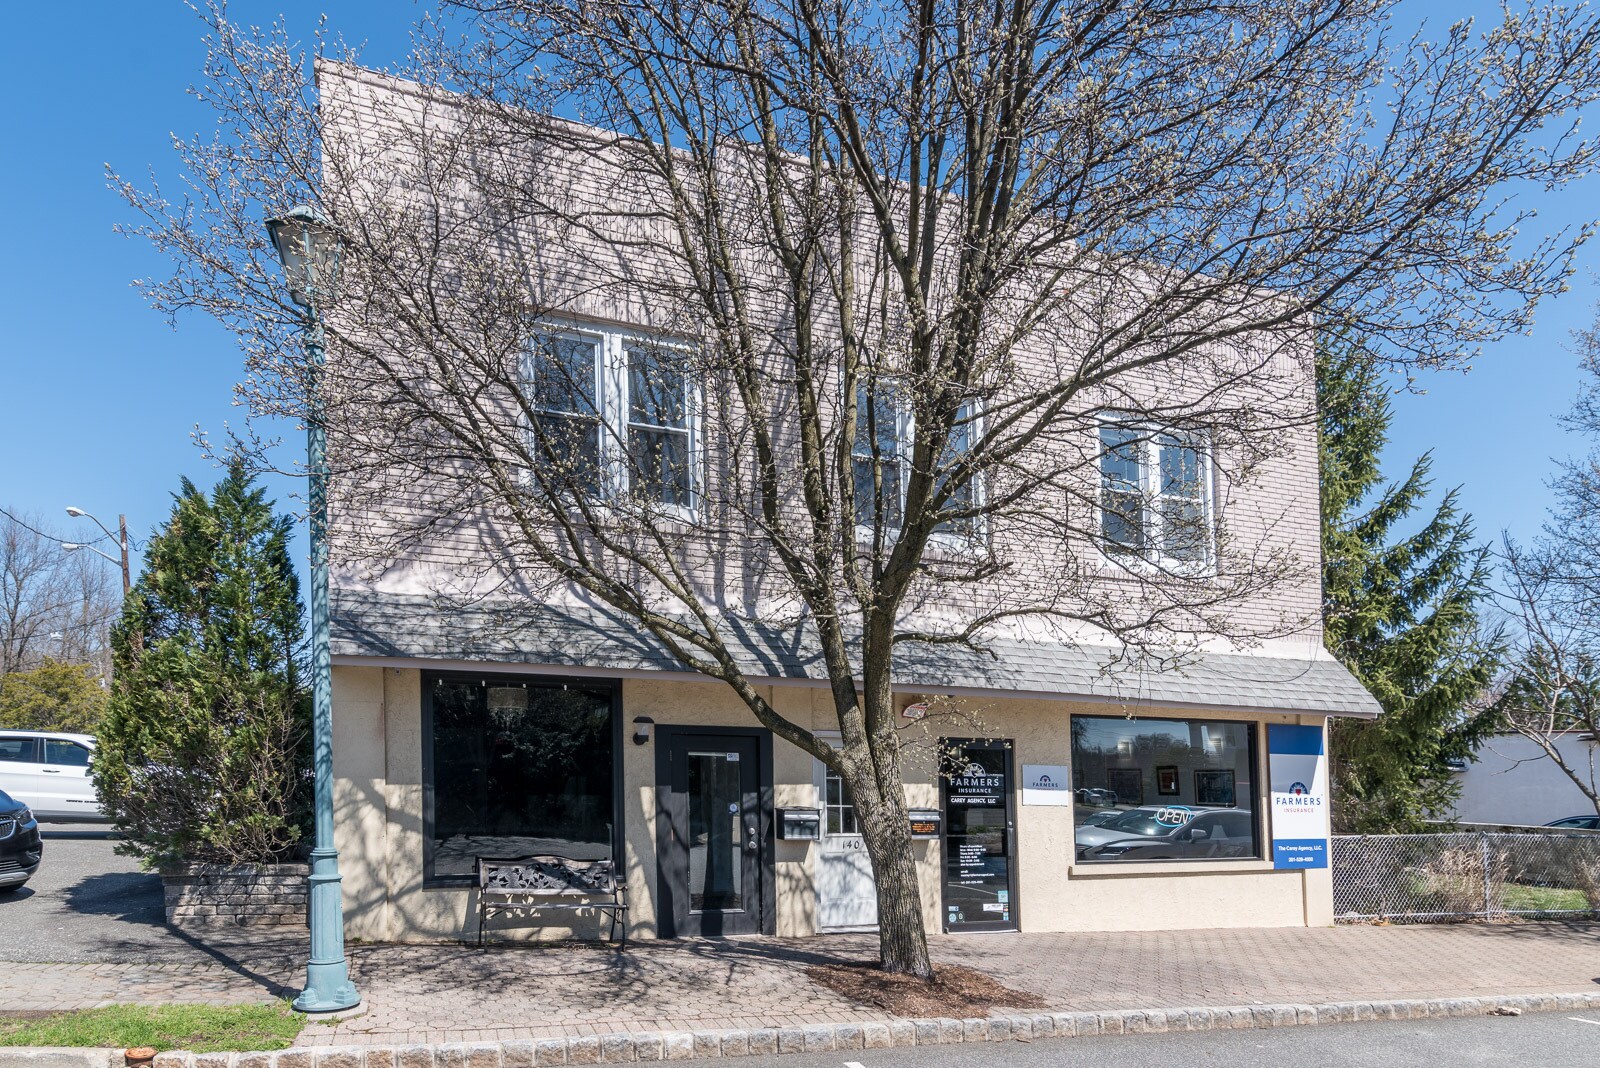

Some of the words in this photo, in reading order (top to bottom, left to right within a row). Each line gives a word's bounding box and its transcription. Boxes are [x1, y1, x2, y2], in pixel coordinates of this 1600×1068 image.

[950, 778, 999, 786] FARMERS
[1276, 797, 1321, 806] FARMERS
[1157, 808, 1188, 824] OPEN
[842, 840, 860, 849] 140
